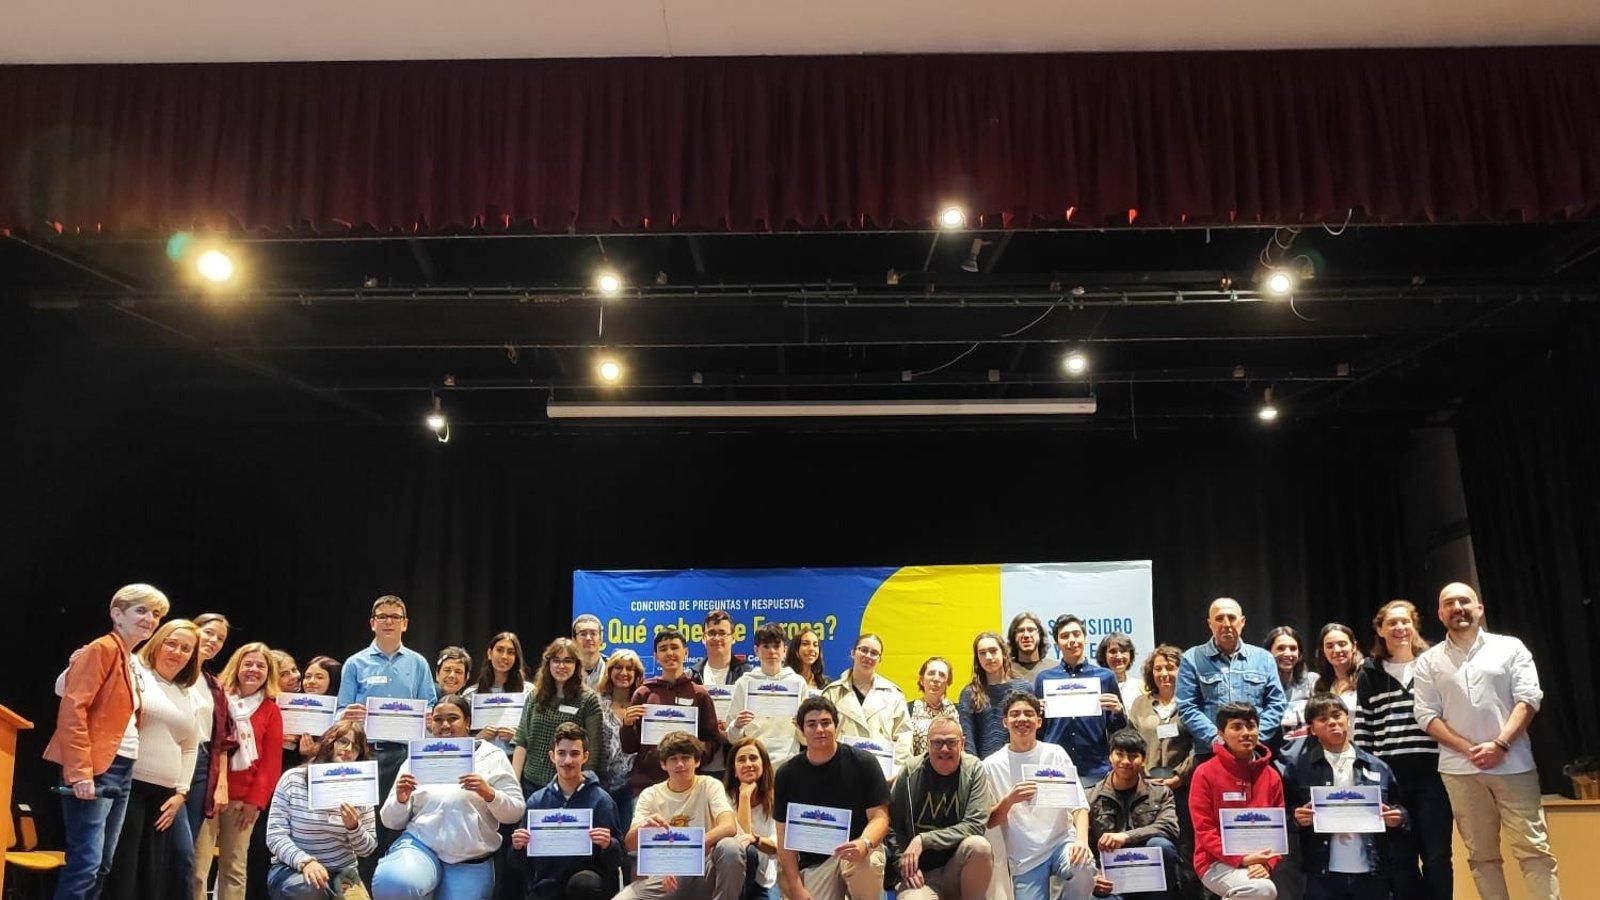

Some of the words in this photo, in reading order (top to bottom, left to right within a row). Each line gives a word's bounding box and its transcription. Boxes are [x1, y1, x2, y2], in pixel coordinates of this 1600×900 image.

[631, 600, 676, 612] CONCURSO
[679, 600, 690, 611] DE
[692, 599, 741, 611] PREGUNTAS
[743, 599, 750, 610] Y
[751, 598, 805, 610] RESPUESTAS
